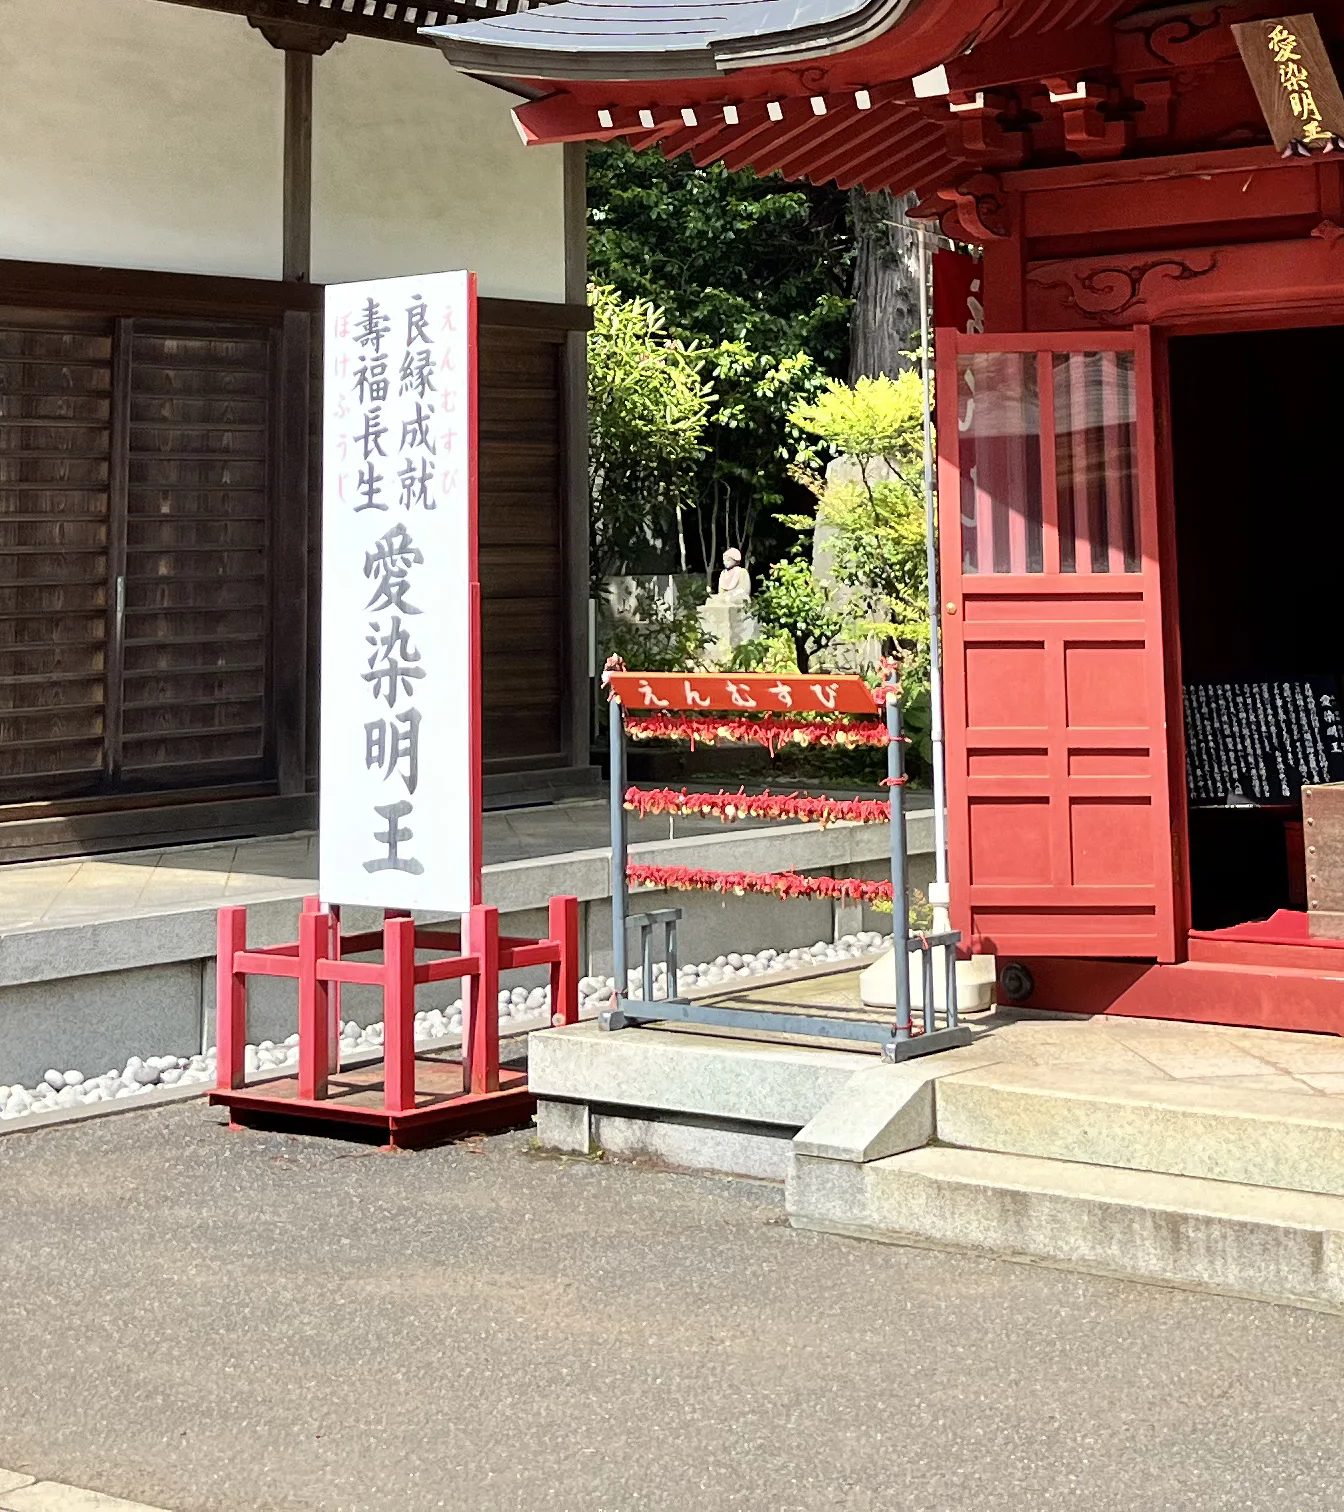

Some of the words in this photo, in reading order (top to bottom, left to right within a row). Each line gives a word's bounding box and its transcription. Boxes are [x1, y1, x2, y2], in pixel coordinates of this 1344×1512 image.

[1268, 24, 1333, 143] 愛染明王
[332, 310, 353, 504] ぼけふうじ
[396, 293, 438, 512] 良縁成就
[439, 305, 459, 496] えんむすび
[360, 521, 427, 876] 愛染明王
[637, 679, 840, 709] えんむすび
